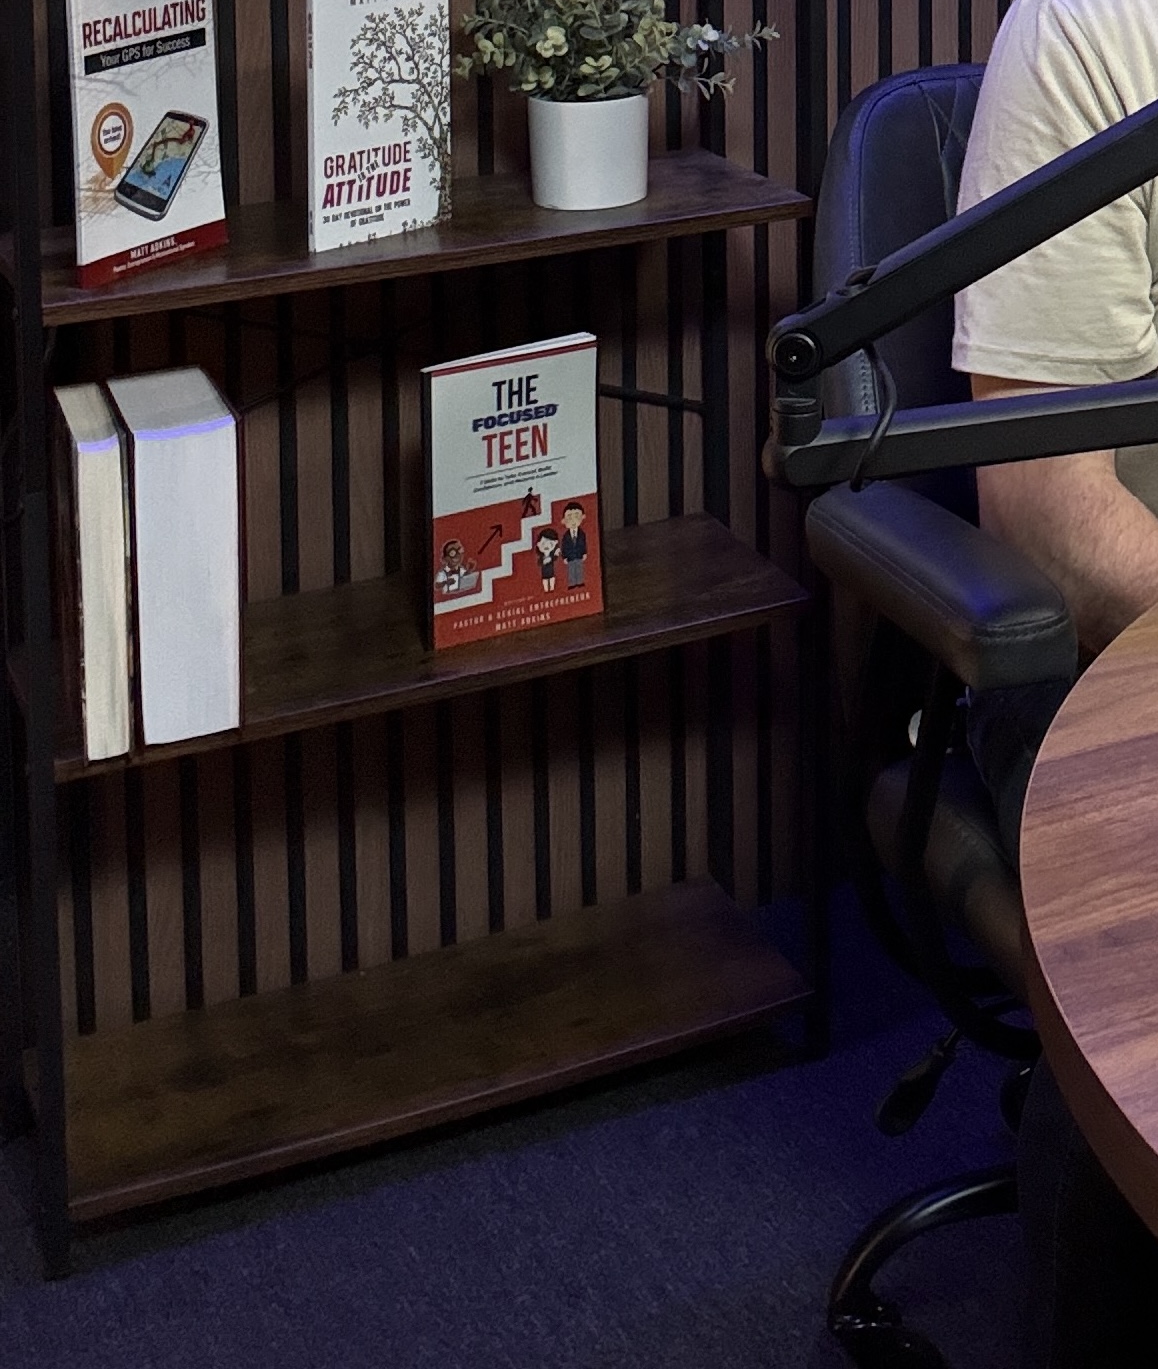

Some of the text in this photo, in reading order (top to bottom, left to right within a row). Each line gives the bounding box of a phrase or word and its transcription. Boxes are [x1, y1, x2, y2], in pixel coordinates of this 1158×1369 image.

[101, 36, 191, 67] Your GPS for Success
[323, 140, 412, 180] GRATITUDE
[321, 167, 413, 210] ATTITUDE
[130, 244, 149, 259] MATT
[491, 373, 539, 411] THE
[472, 403, 559, 433] FOCUSED
[481, 422, 549, 469] TEEN
